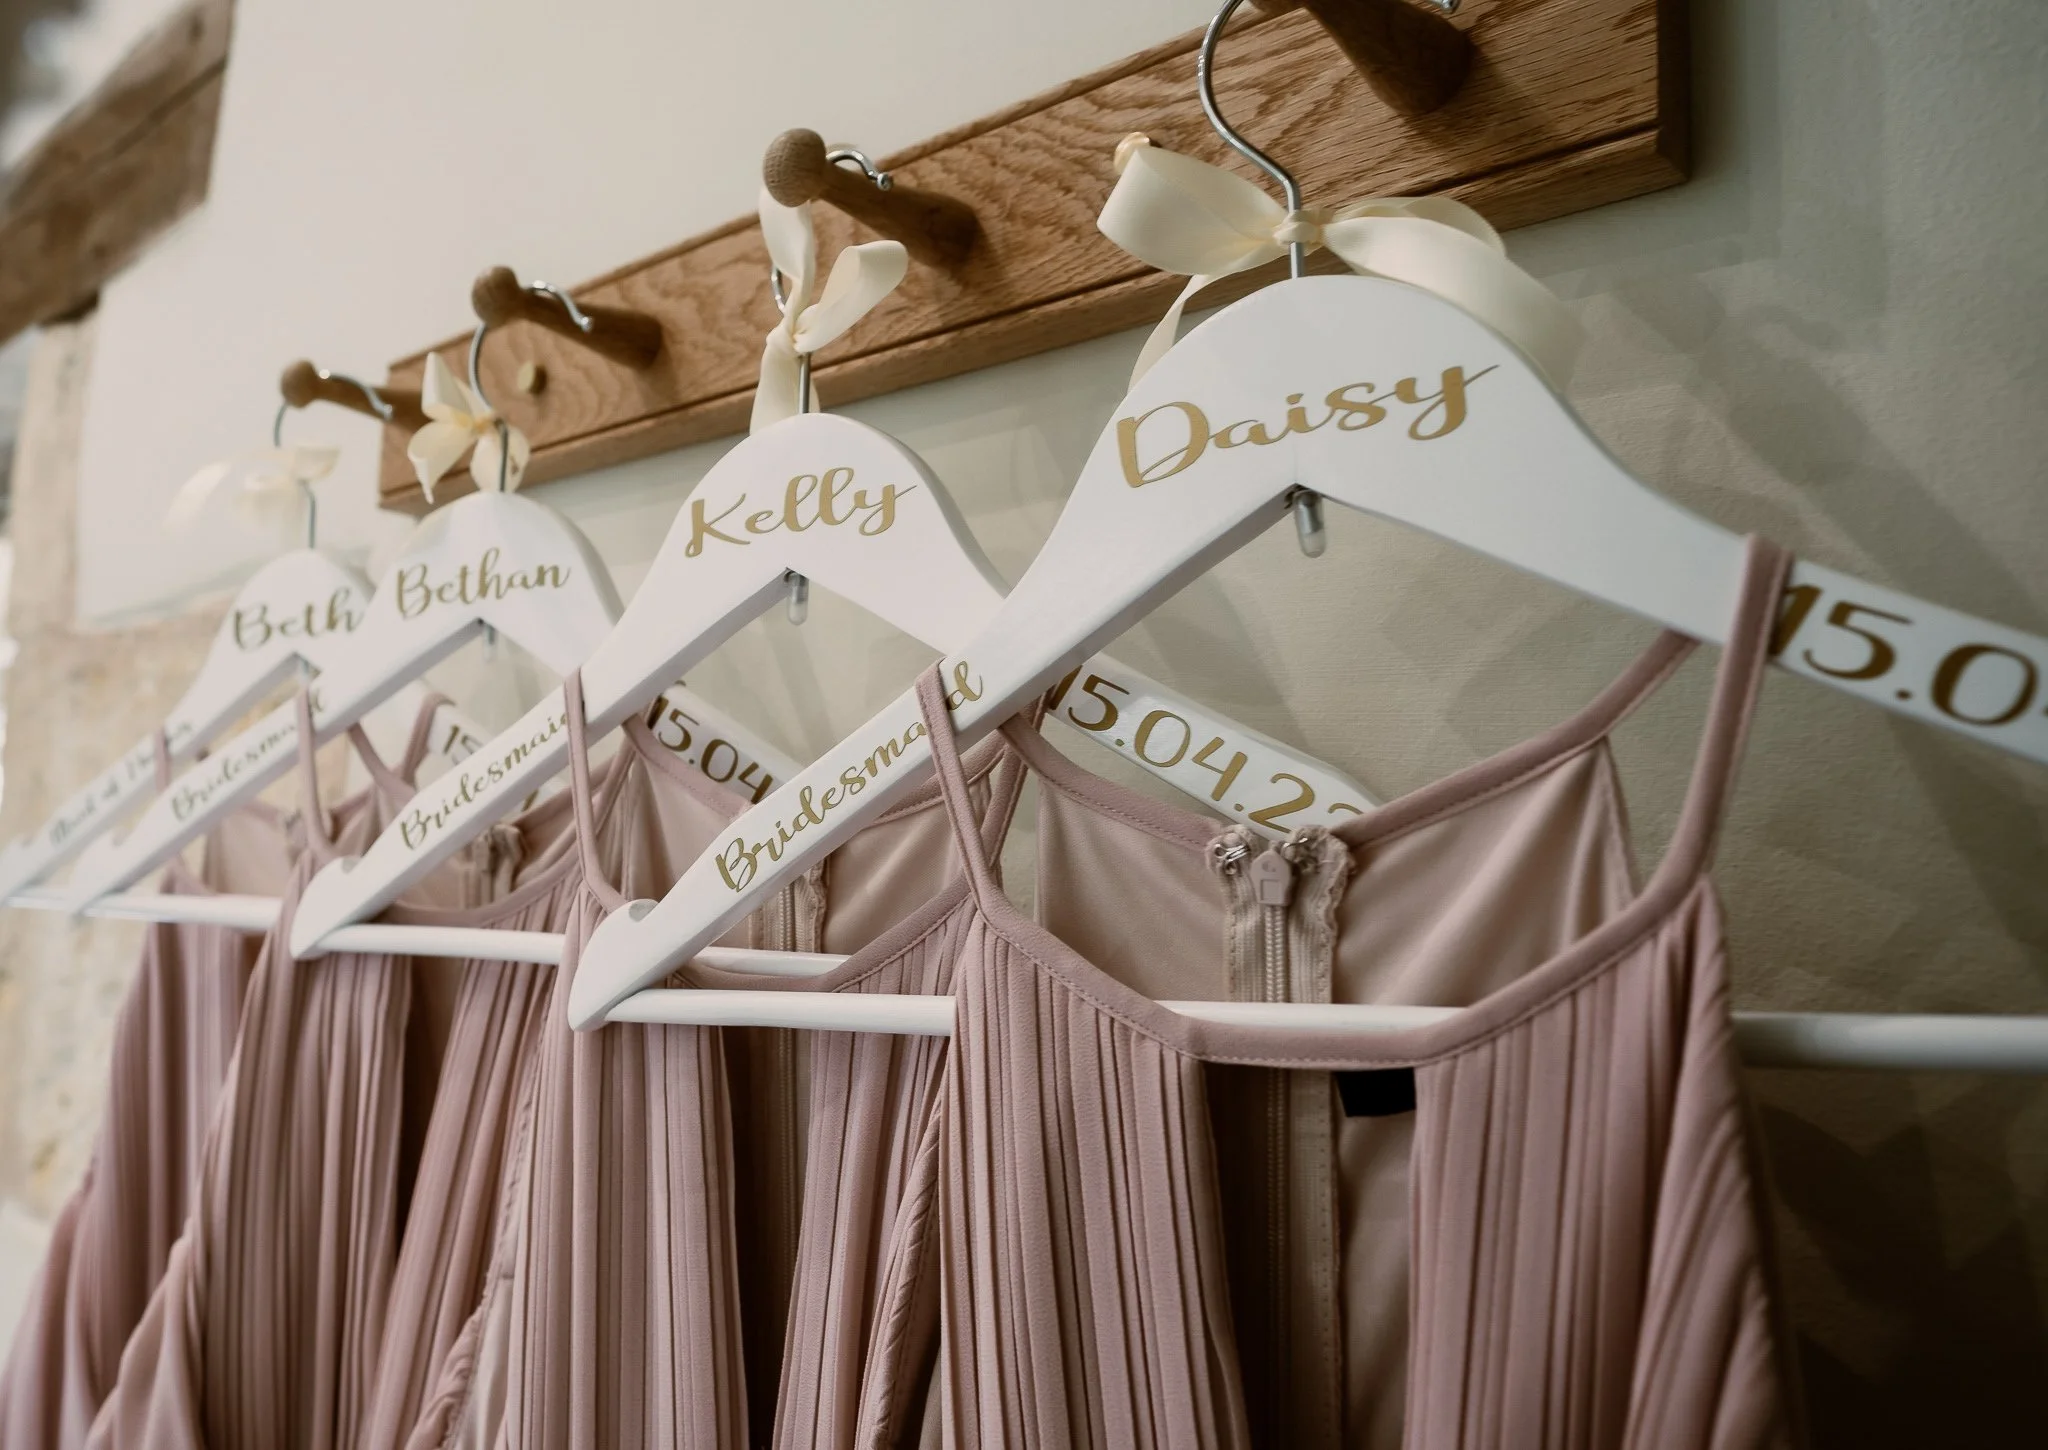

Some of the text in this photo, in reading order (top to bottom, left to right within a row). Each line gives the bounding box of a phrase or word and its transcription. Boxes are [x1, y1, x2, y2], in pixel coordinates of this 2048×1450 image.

[1117, 364, 1500, 489] Daisy
[684, 467, 918, 558] Kelly
[233, 585, 365, 651] Beth
[396, 546, 571, 619] Bethan
[1767, 584, 2048, 727] 15.0
[714, 660, 984, 892] Bridesmad
[1045, 664, 1366, 834] 15.04.2
